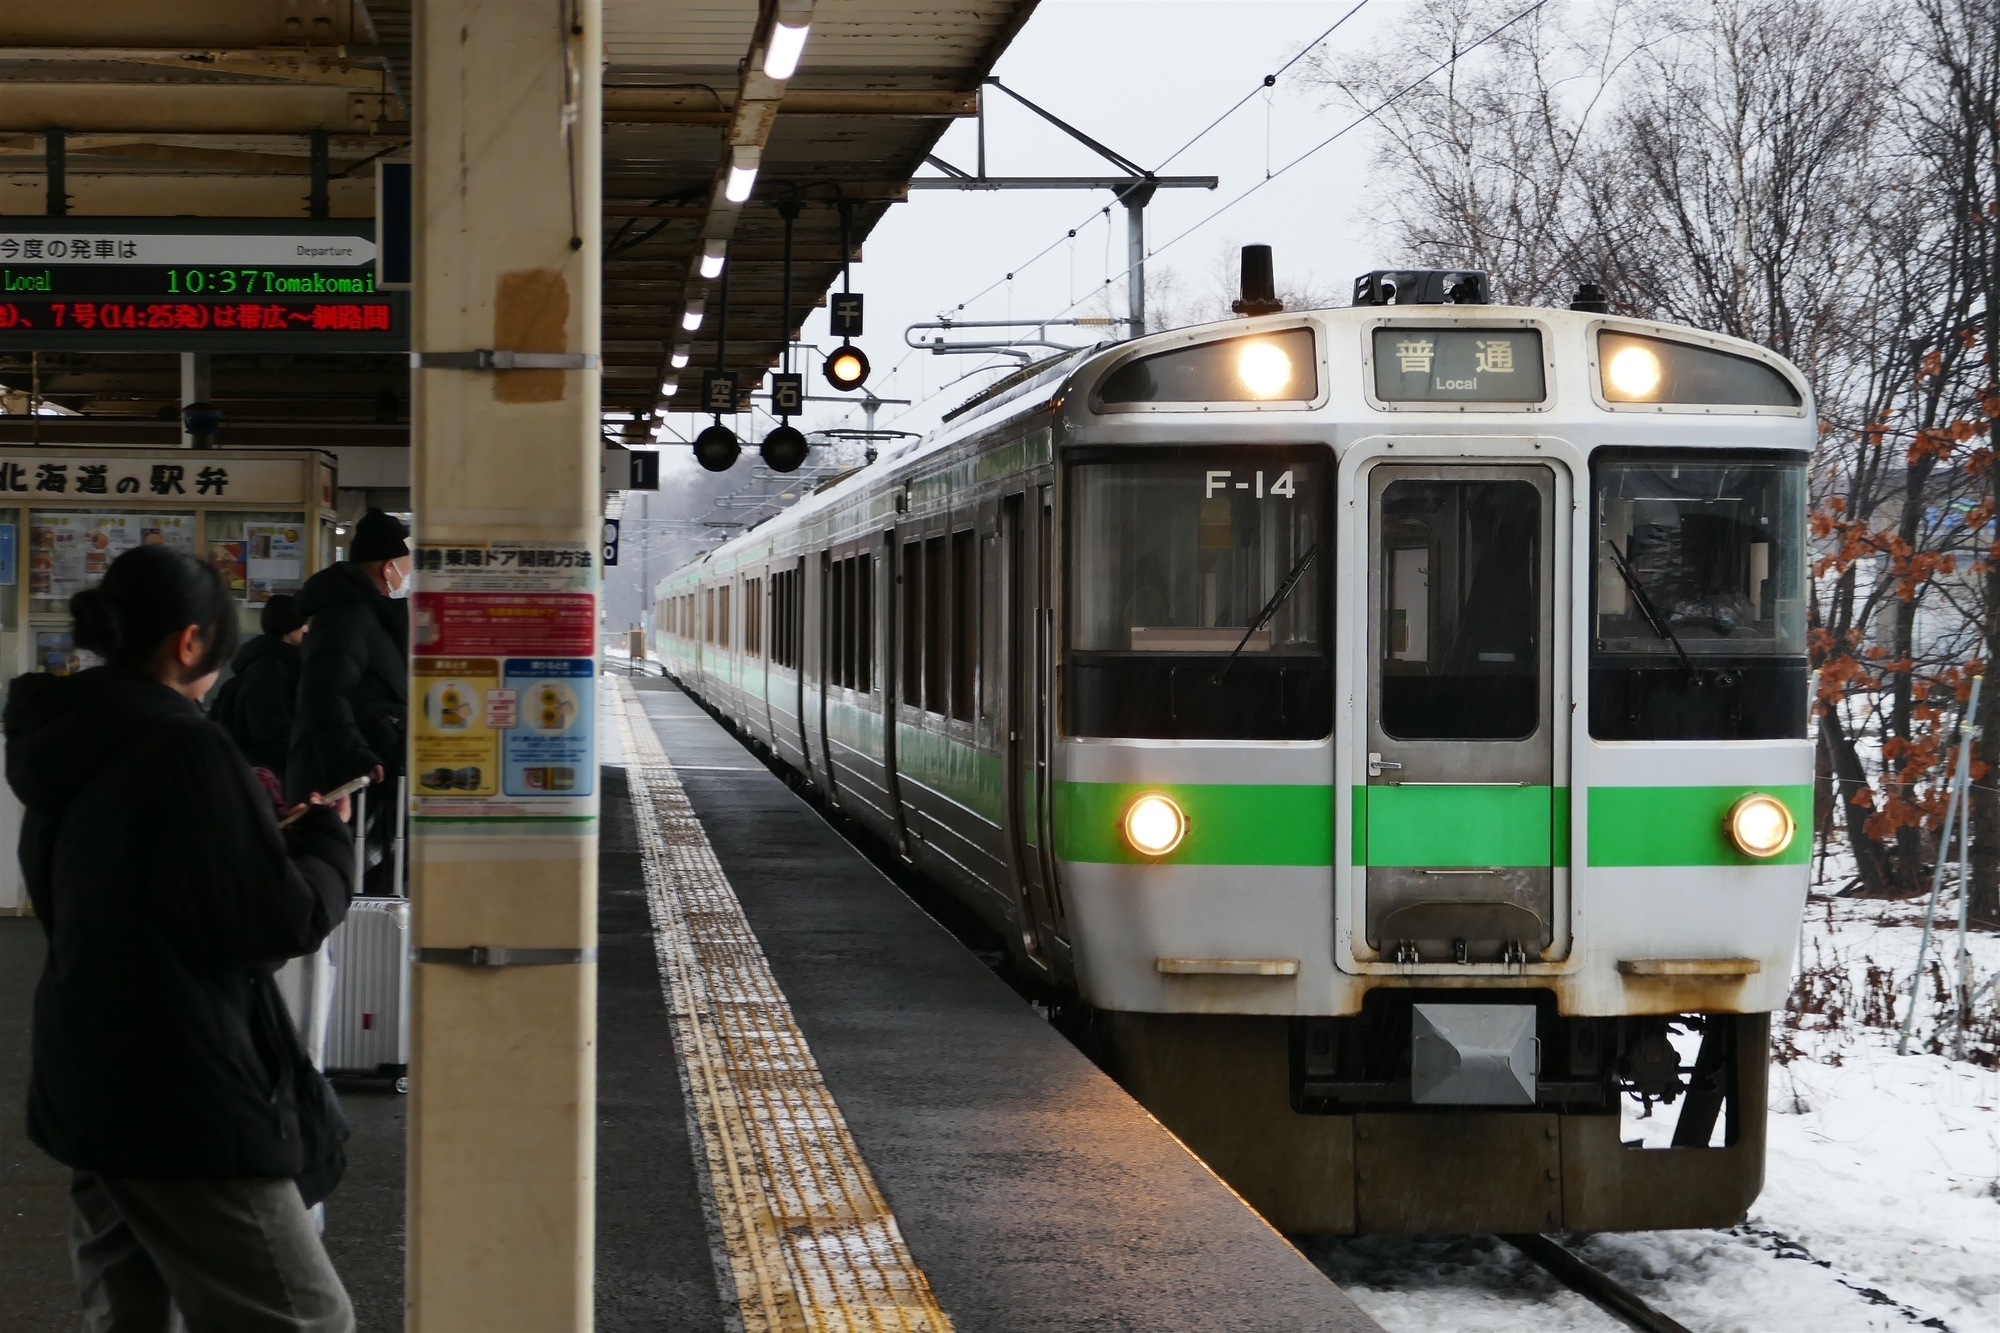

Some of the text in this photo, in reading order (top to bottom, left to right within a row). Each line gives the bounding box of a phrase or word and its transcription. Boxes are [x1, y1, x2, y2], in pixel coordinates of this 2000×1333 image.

[0, 238, 137, 259] 今度の発車は
[297, 245, 353, 257] Departure
[5, 270, 375, 293] Local 10:37 Tomakomai
[839, 301, 859, 328] 千
[1396, 339, 1515, 373] 普通
[711, 378, 731, 408] 空
[776, 382, 797, 407] 石
[1436, 377, 1477, 390] Local
[0, 462, 228, 495] 北海道の駅弁
[632, 459, 643, 482] 1
[1206, 471, 1295, 498] F-14
